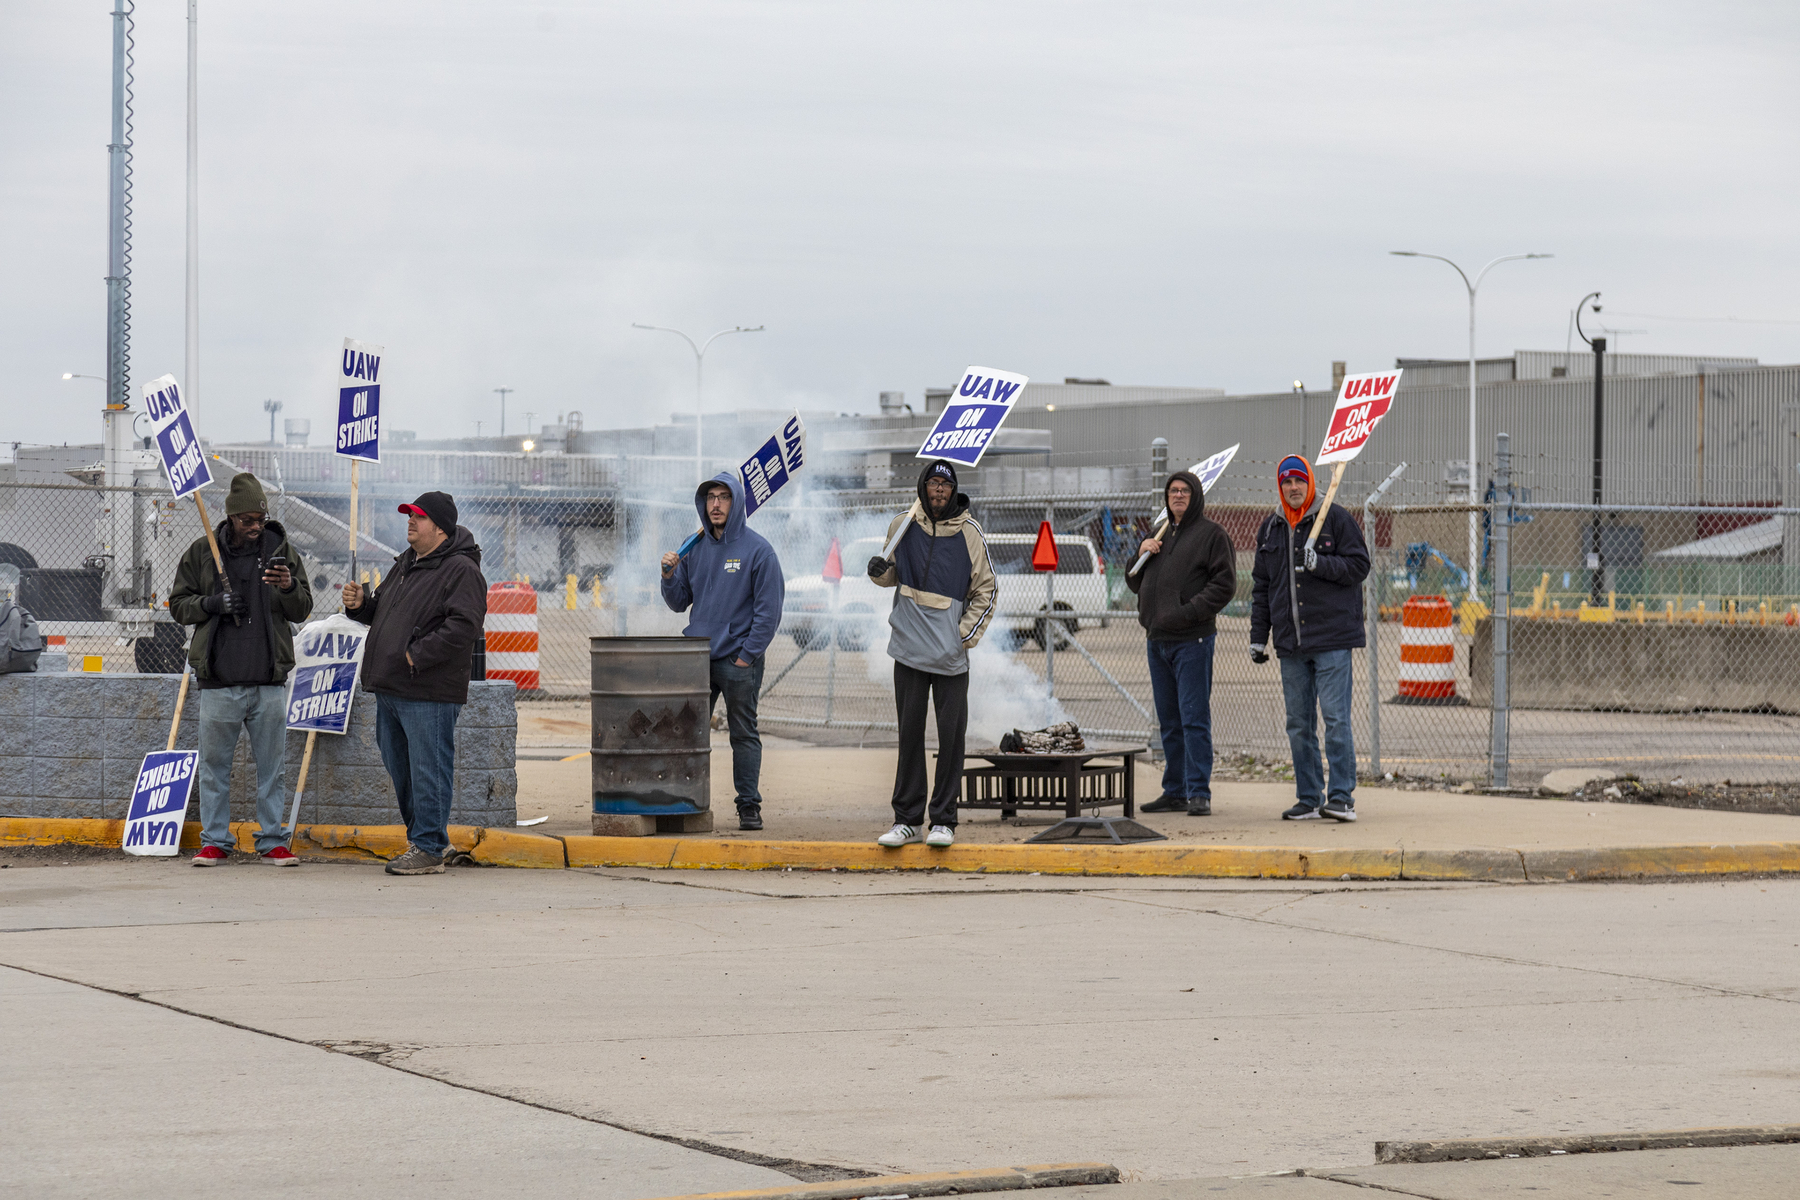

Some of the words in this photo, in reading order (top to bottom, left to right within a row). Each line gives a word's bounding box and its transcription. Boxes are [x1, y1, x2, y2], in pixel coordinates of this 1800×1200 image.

[342, 348, 381, 382] UAW
[959, 374, 1021, 403] UAW
[1344, 375, 1397, 399] UAW
[146, 384, 181, 422] UAW
[352, 390, 368, 418] ON
[1346, 402, 1372, 427] ON
[338, 415, 378, 449] STRIKE
[955, 407, 987, 429] ON
[169, 422, 187, 455] ON
[783, 415, 803, 473] UAW
[925, 428, 992, 452] STRIKE
[170, 439, 202, 491] STRIKE
[764, 454, 783, 480] ON
[1194, 450, 1233, 475] AW
[744, 457, 772, 506] STRIKE
[302, 631, 363, 660] UAW
[311, 667, 336, 694] ON
[289, 690, 349, 723] STRIKE
[137, 756, 193, 793] STRIKE
[146, 785, 171, 813] ON
[125, 821, 178, 847] UAW
